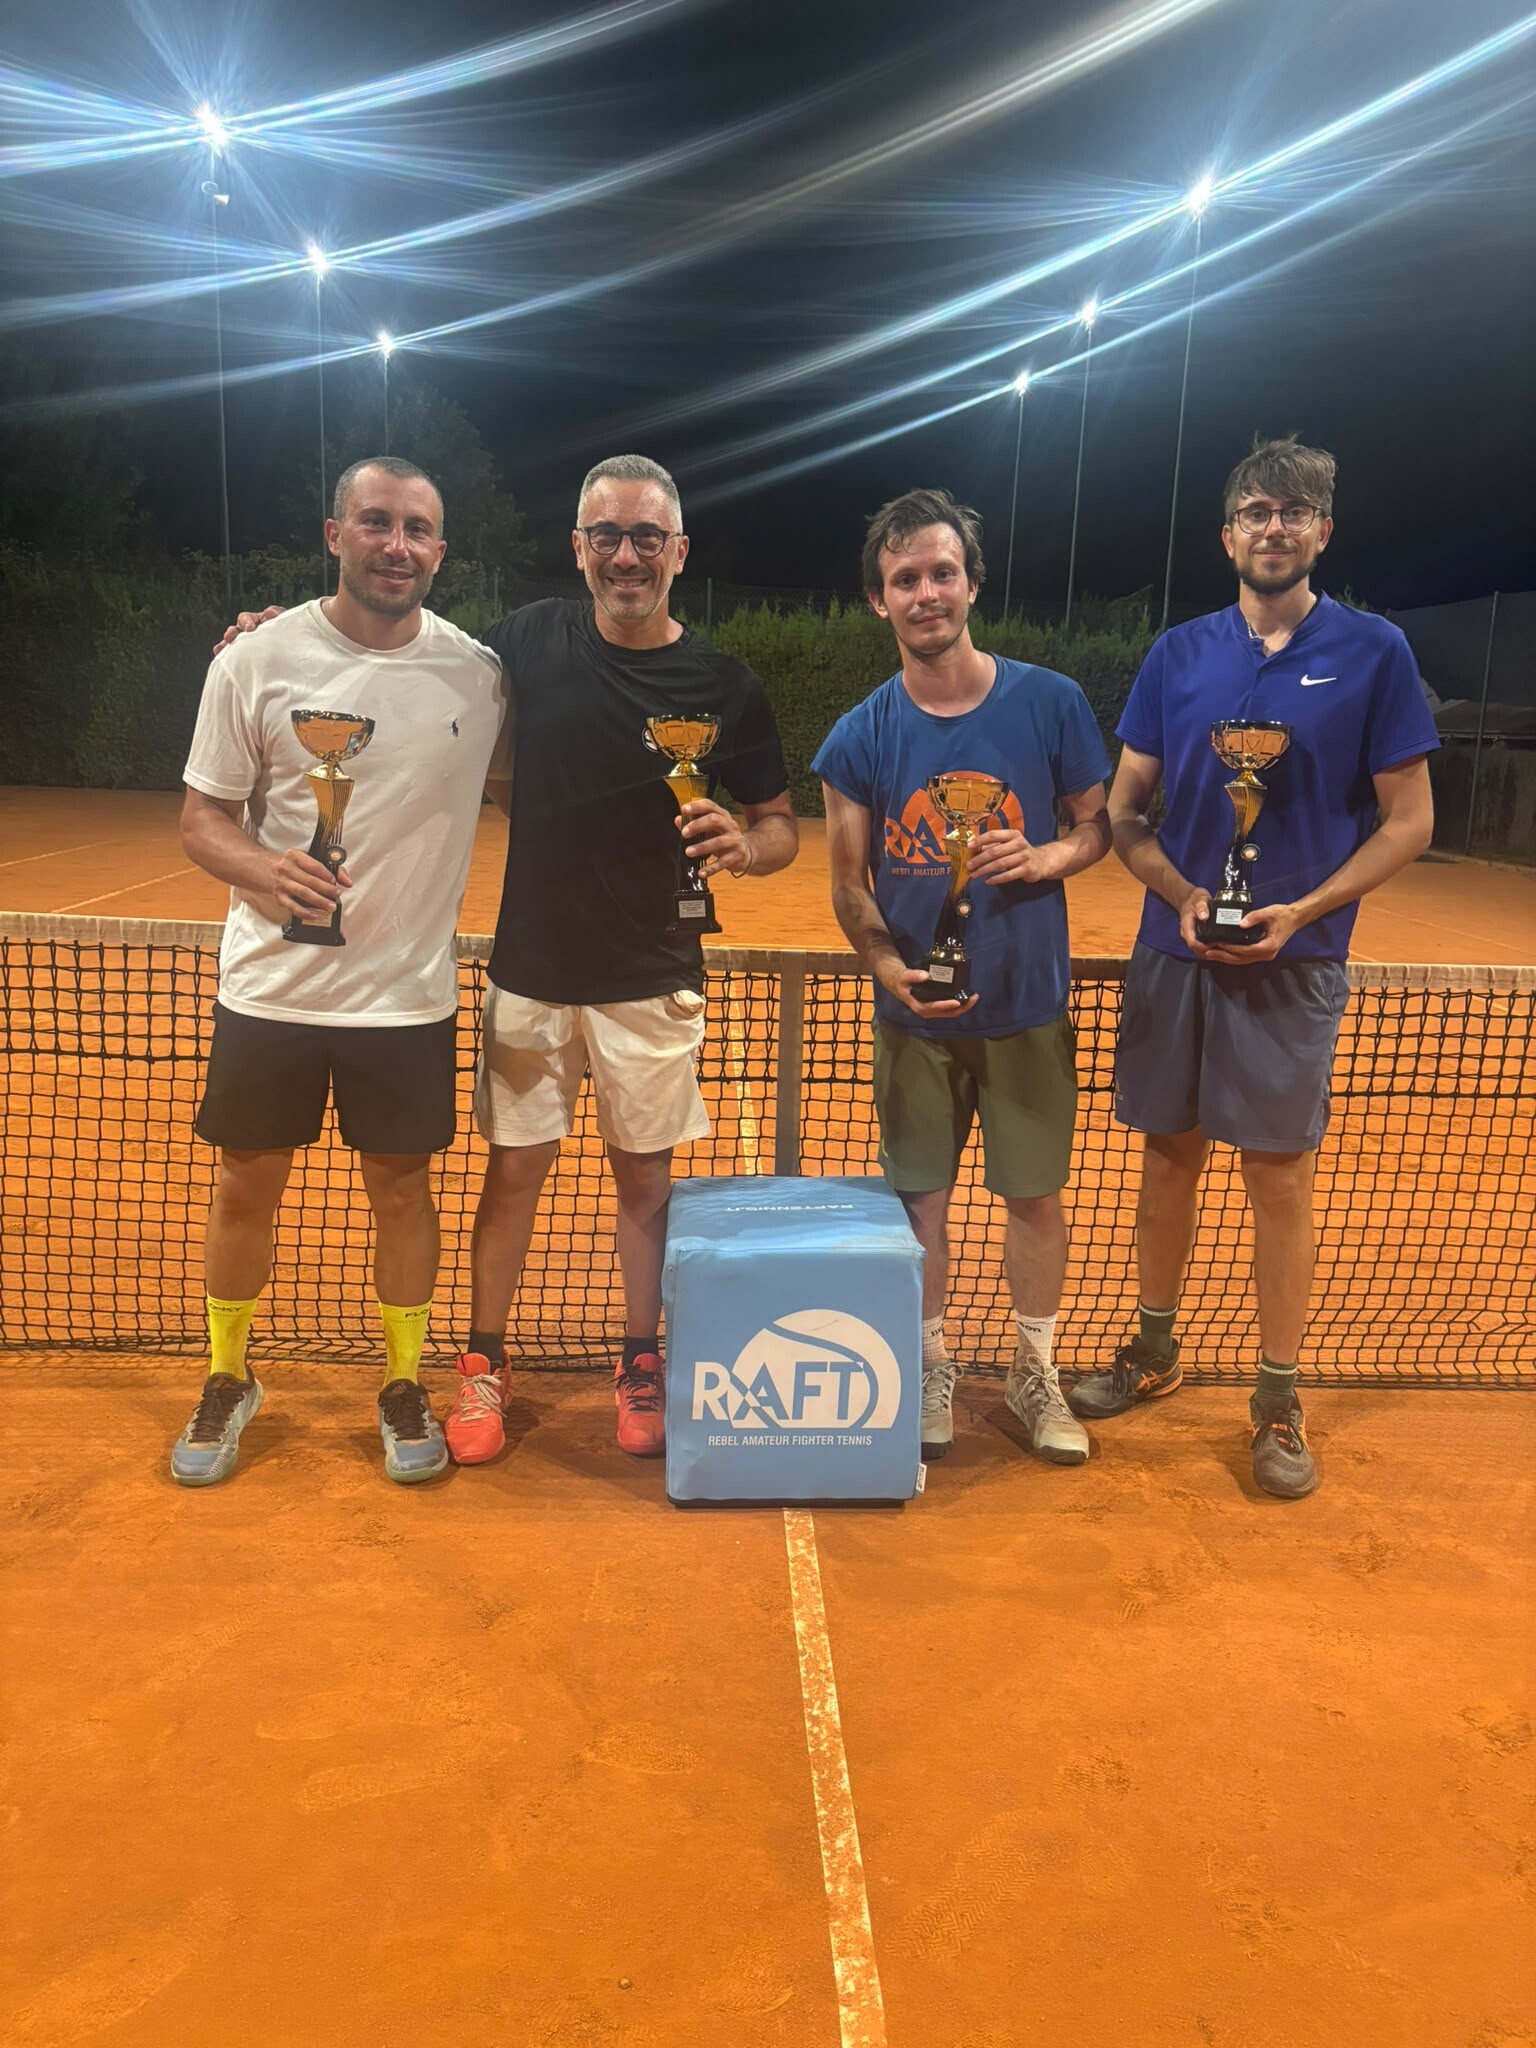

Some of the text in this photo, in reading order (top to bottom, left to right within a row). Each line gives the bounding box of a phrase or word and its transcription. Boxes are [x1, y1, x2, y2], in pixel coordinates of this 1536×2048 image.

[891, 867, 911, 876] REBEL
[913, 867, 945, 876] AMATEUR
[691, 1361, 865, 1421] RAFT
[708, 1435, 873, 1446] REBEL AMATEUR FIGHTER TENNIS
